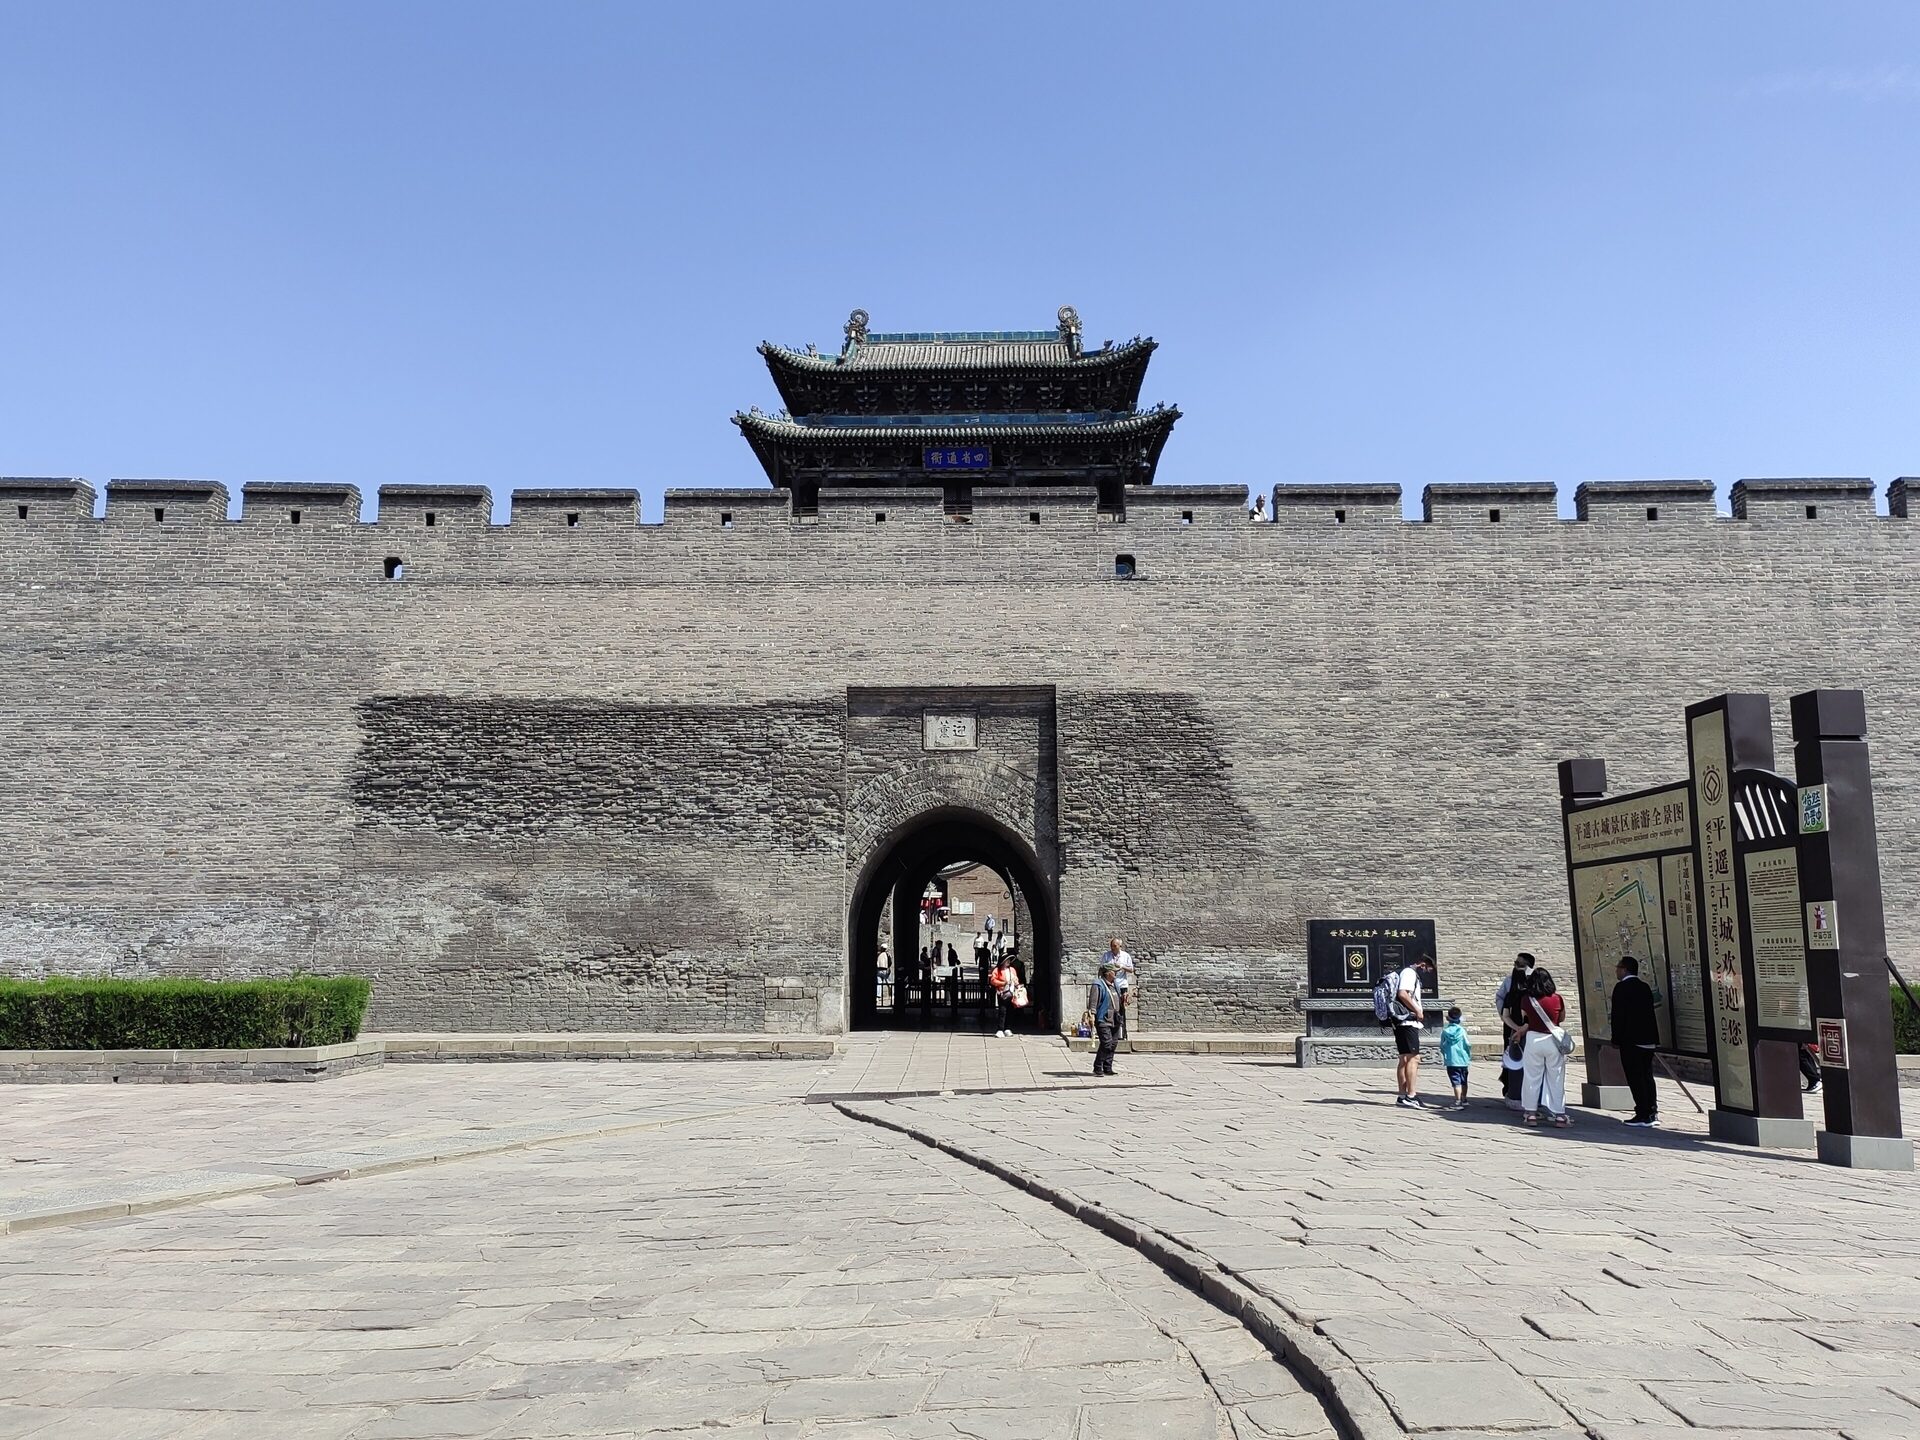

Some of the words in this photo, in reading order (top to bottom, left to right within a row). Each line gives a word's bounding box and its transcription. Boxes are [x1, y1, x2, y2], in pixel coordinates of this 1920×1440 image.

[1574, 801, 1684, 841] 平遥古城景区旅游全景图
[1705, 820, 1715, 880] Welcome
[1709, 885, 1716, 898] to
[1329, 928, 1379, 938] 世界文化遗产
[1383, 928, 1417, 938] 平遥古城
[1711, 903, 1720, 955] Pingyao
[1711, 815, 1743, 1047] 平遥古城欢迎您
[1715, 962, 1725, 1011] Ancient
[1719, 1017, 1728, 1044] City
